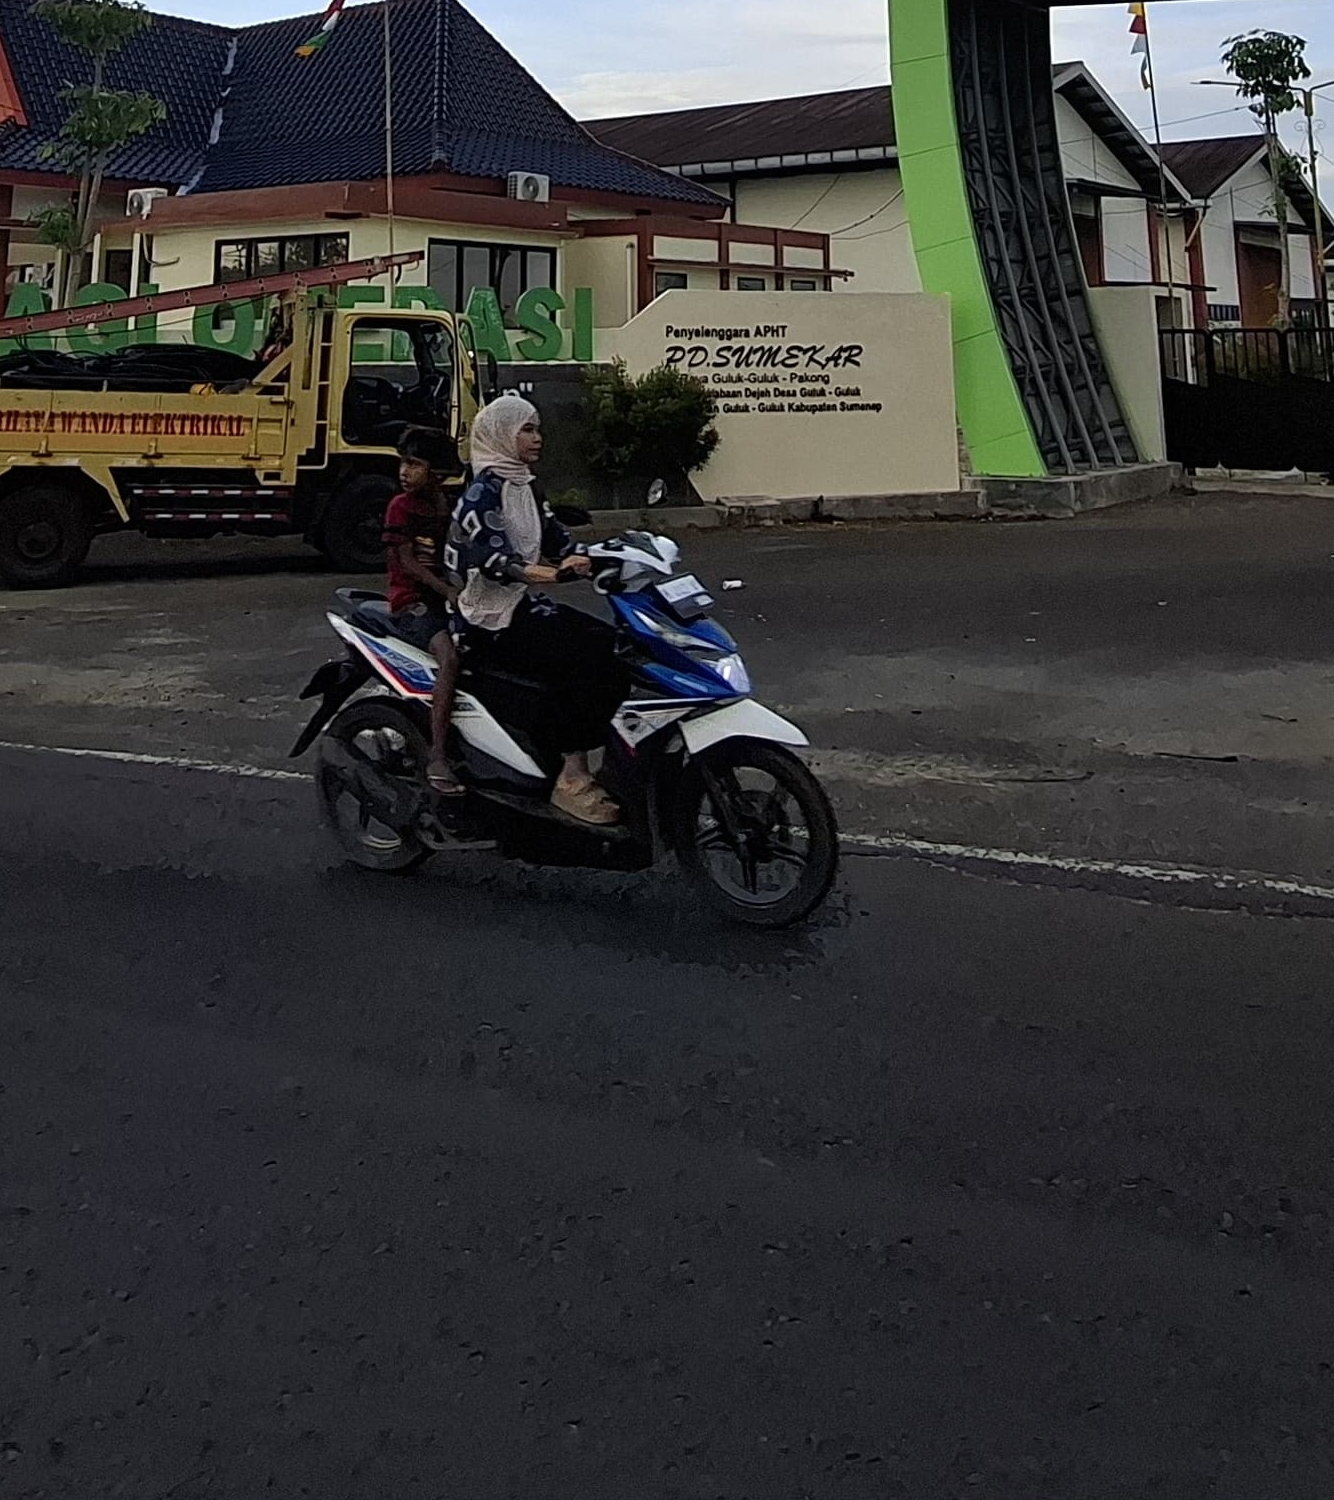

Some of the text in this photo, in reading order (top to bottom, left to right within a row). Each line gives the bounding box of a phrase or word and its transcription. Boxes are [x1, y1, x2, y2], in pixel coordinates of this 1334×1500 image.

[665, 325, 788, 340] Penyelenggara APHT
[665, 344, 864, 370] PD.SUMEKAR
[712, 372, 780, 383] Guluk-Guluk
[790, 372, 830, 385] Pakong
[773, 387, 797, 397] Desa
[800, 387, 826, 397] Guluk
[834, 386, 861, 397] Guluk
[723, 403, 751, 413] Guluk
[758, 402, 786, 413] Guluk
[788, 402, 837, 414] Kabupaten
[839, 401, 882, 413] Sumenep
[60, 411, 125, 435] WANDA
[130, 412, 245, 437] ELEKTRIKAL
